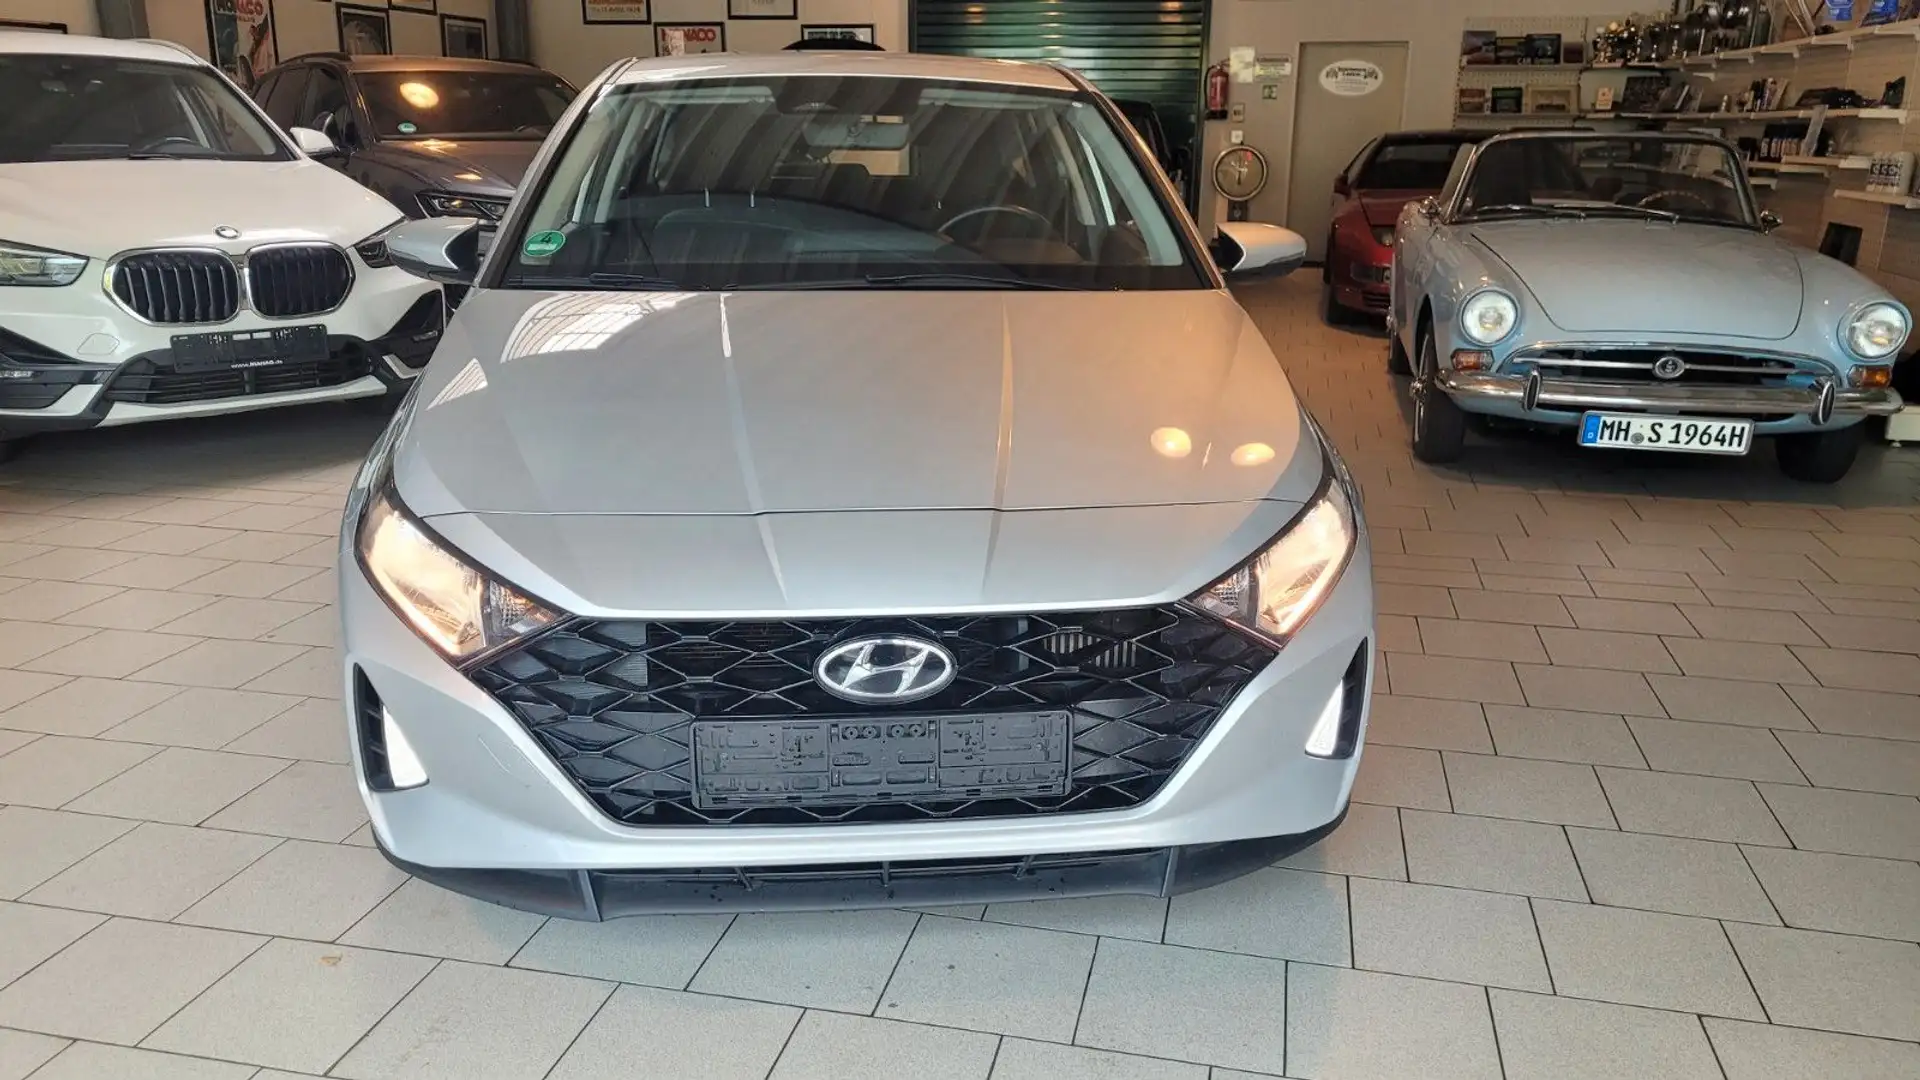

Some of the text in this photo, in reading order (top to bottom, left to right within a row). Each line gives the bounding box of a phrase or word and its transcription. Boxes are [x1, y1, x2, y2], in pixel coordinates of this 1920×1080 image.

[1599, 420, 1745, 448] MH S 1964H
